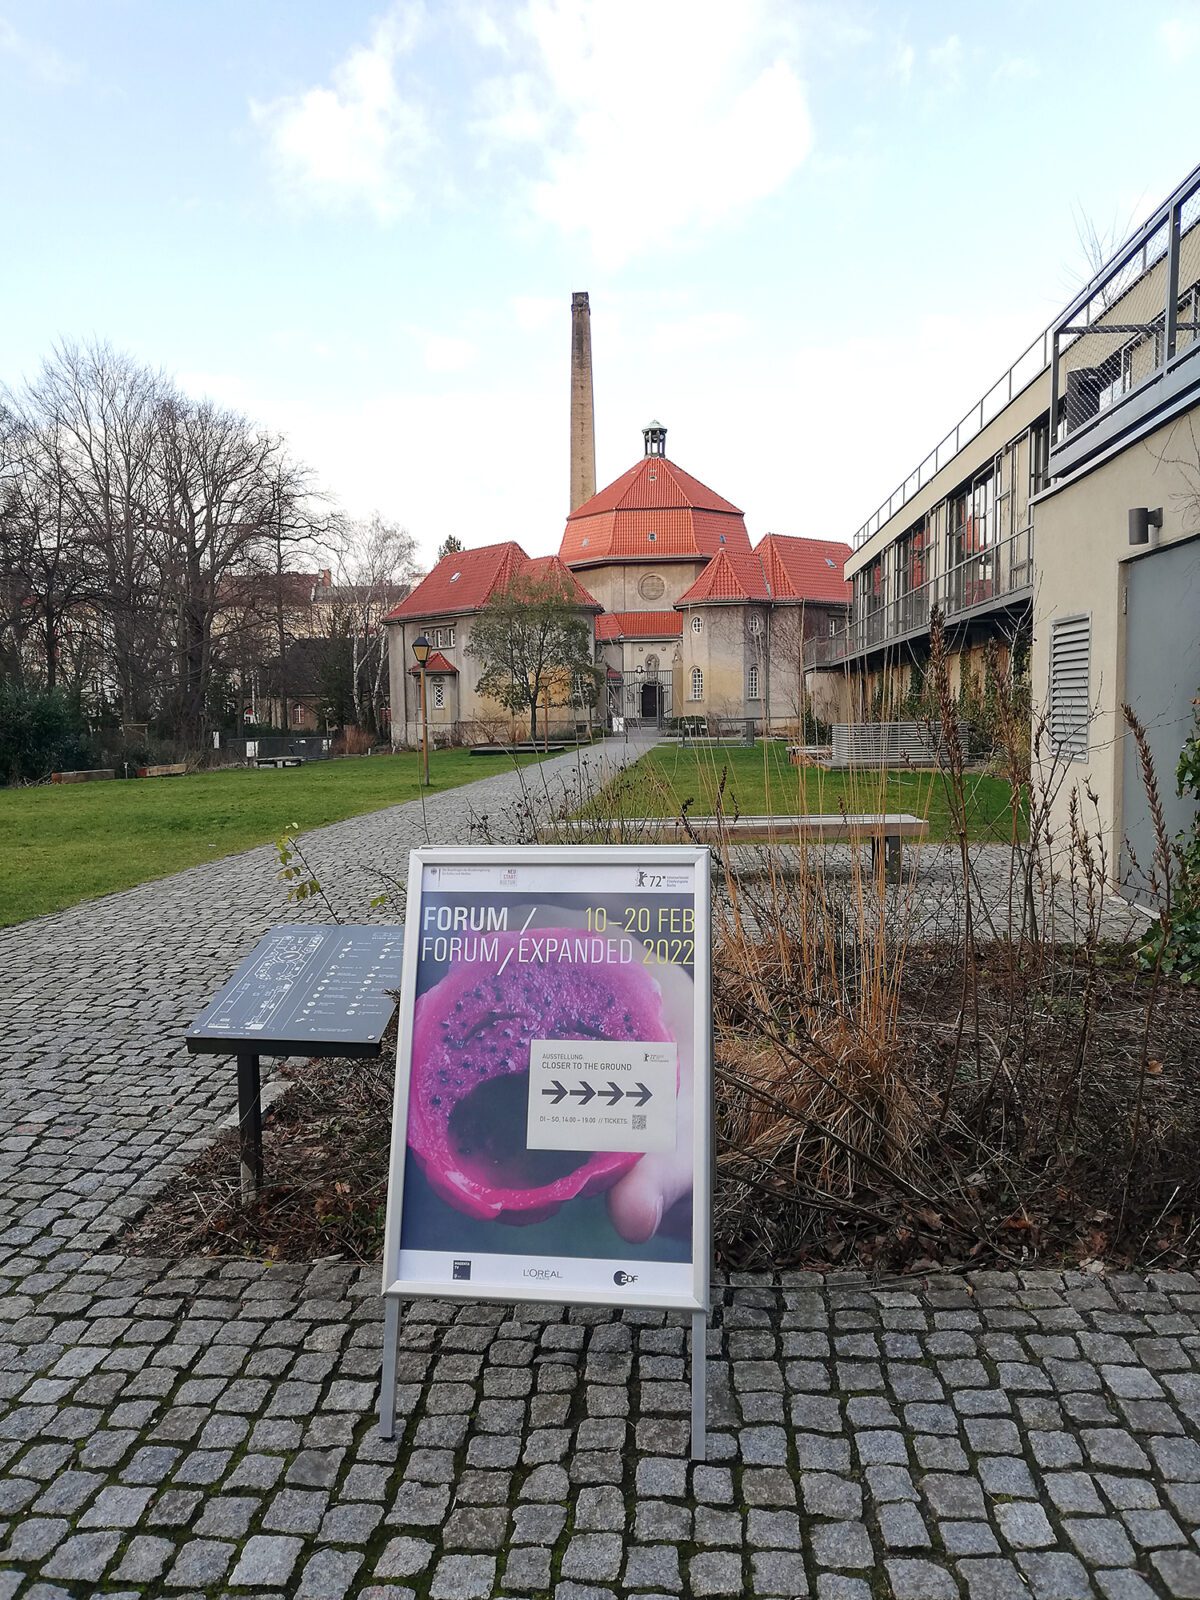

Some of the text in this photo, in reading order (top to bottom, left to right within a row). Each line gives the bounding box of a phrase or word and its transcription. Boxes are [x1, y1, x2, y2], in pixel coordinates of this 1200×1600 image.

[423, 906, 508, 931] FORUM
[658, 908, 694, 933] FEB
[642, 939, 694, 965] 2022
[541, 1061, 632, 1071] CLOSER TO THE GROUND
